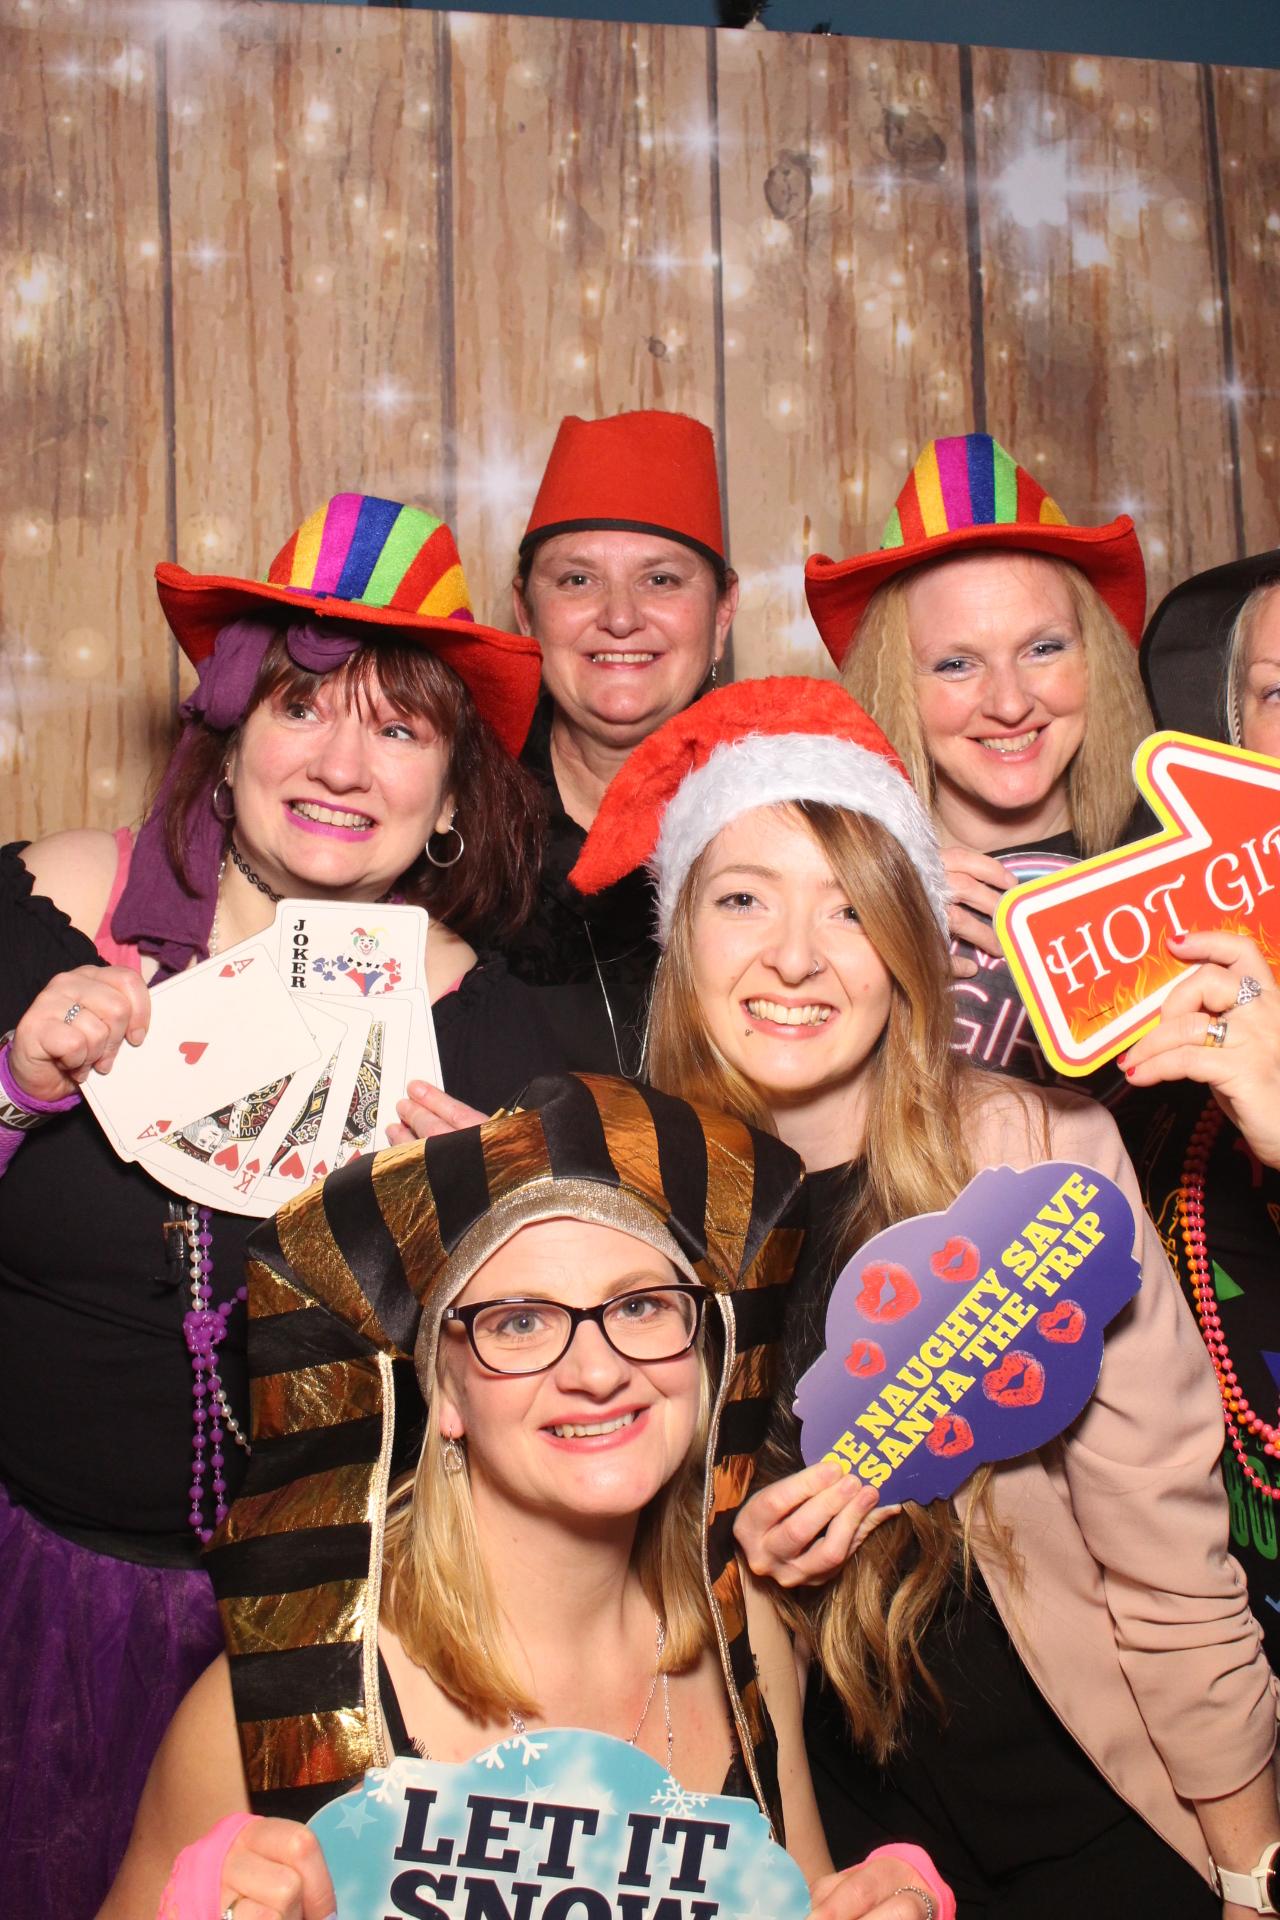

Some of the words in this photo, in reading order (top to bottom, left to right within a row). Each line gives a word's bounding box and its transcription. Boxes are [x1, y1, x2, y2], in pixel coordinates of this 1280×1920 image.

[232, 957, 255, 975] A
[290, 919, 309, 989] JOKER
[1045, 873, 1189, 995] HOT
[136, 1124, 159, 1140] A
[233, 1170, 256, 1194] K
[854, 1267, 1011, 1440] NAUGHTY
[1001, 1172, 1100, 1277] SAVE
[858, 1368, 977, 1489] SANTA
[960, 1292, 1040, 1368] THE
[1022, 1211, 1106, 1298] TRIP
[393, 1786, 599, 1880] LET
[617, 1812, 730, 1894] IT
